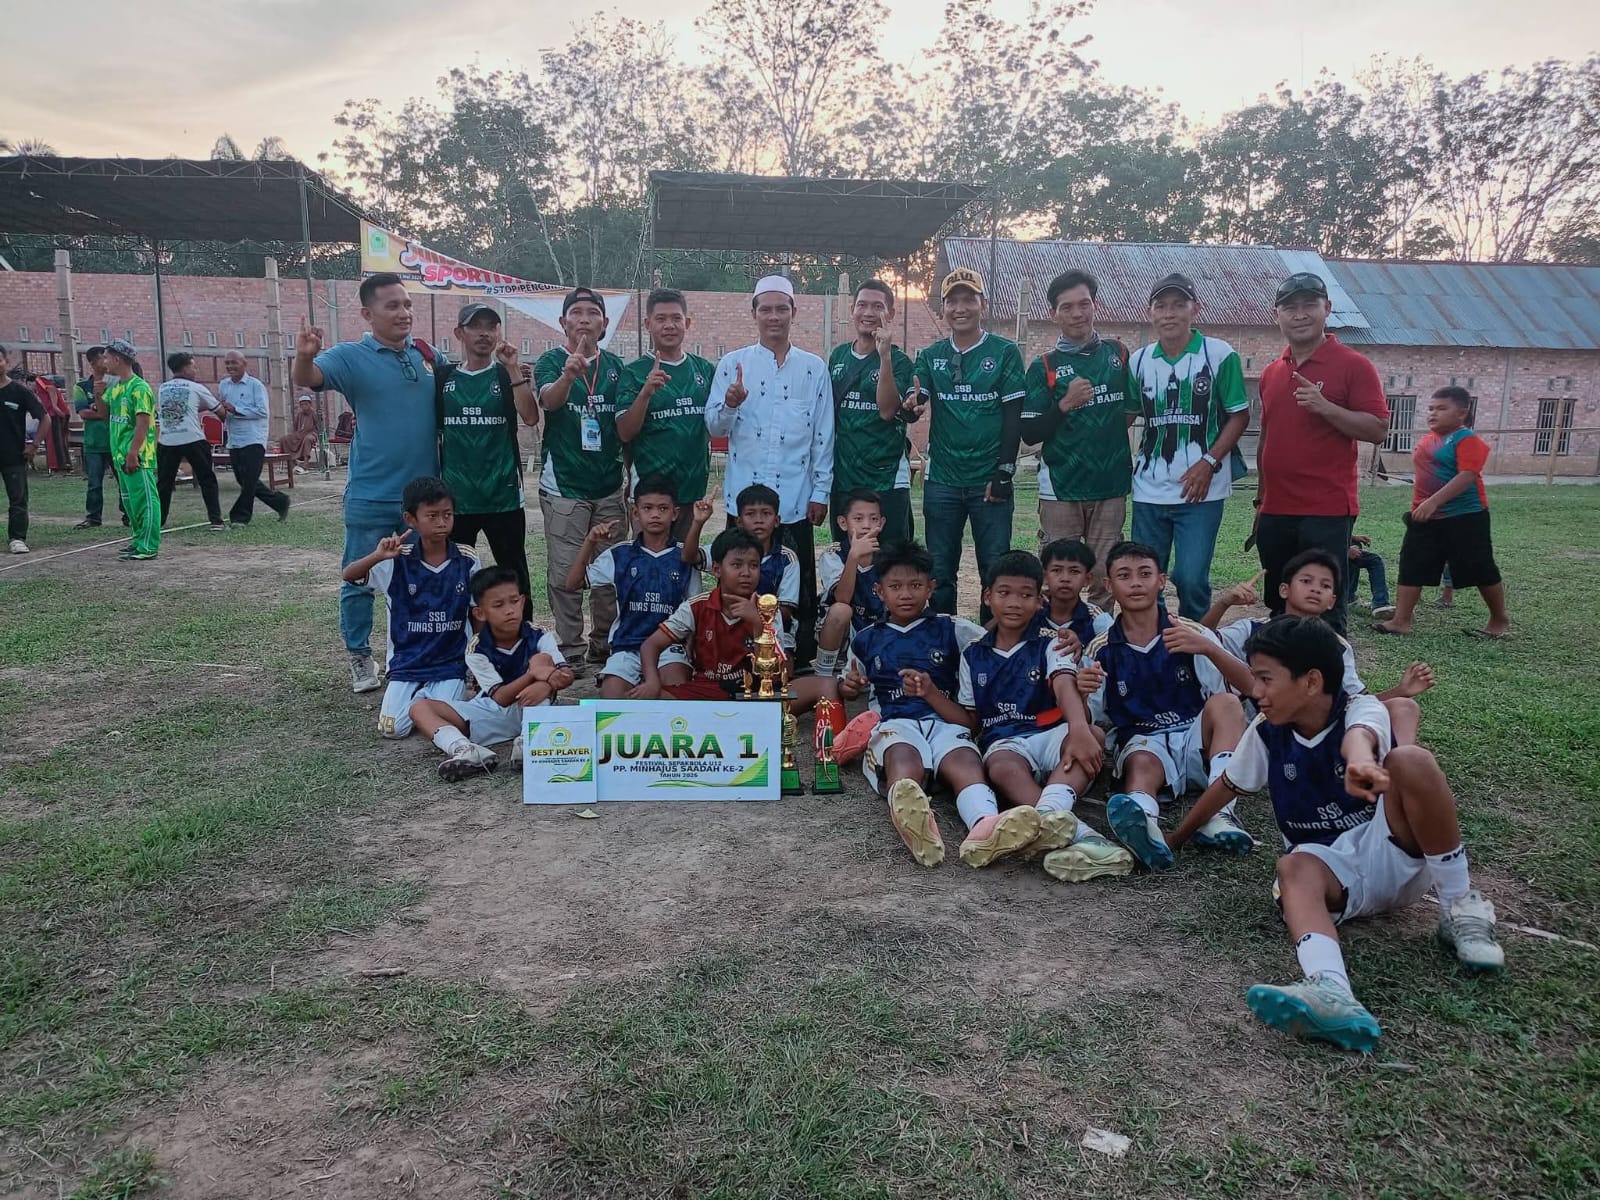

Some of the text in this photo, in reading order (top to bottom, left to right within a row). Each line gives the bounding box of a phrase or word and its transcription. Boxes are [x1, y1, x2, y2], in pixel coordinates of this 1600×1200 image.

[954, 384, 972, 393] SSB
[675, 397, 693, 407] SSB
[462, 406, 482, 416] SSB
[650, 408, 683, 420] TUNAS
[443, 416, 507, 426] UNAS BANGSA
[428, 611, 447, 622] SSB
[407, 621, 434, 633] TUNAS
[1154, 711, 1181, 725] SSB
[556, 747, 590, 756] PLAYER
[598, 733, 759, 765] JUARA 1
[613, 765, 744, 775] PP. MINHAJUS SAADAH KE-2
[1317, 802, 1343, 820] SSB
